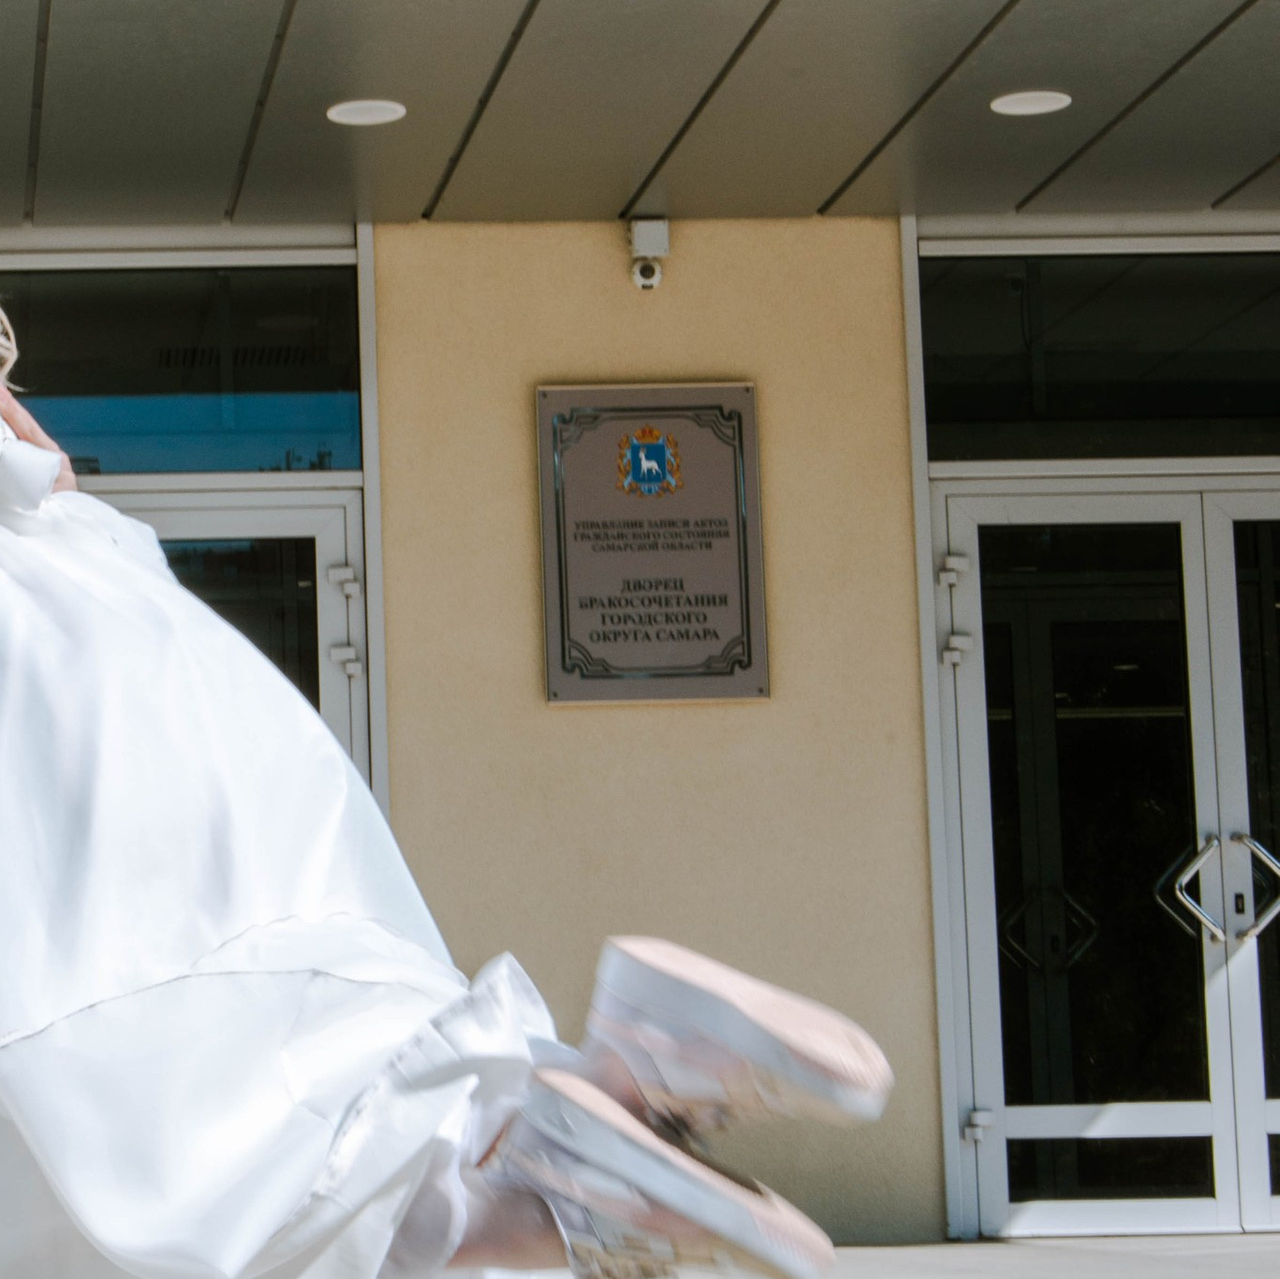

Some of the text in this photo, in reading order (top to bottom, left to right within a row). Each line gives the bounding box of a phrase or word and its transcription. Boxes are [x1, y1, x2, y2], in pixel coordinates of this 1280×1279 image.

[621, 577, 685, 593] ДВОРЕЦ
[578, 593, 729, 610] БРАКОСОЧЕТАНИЯ
[600, 611, 708, 626] ГОРОДСКОГО
[588, 627, 720, 643] ОКРУГА САМАРА
